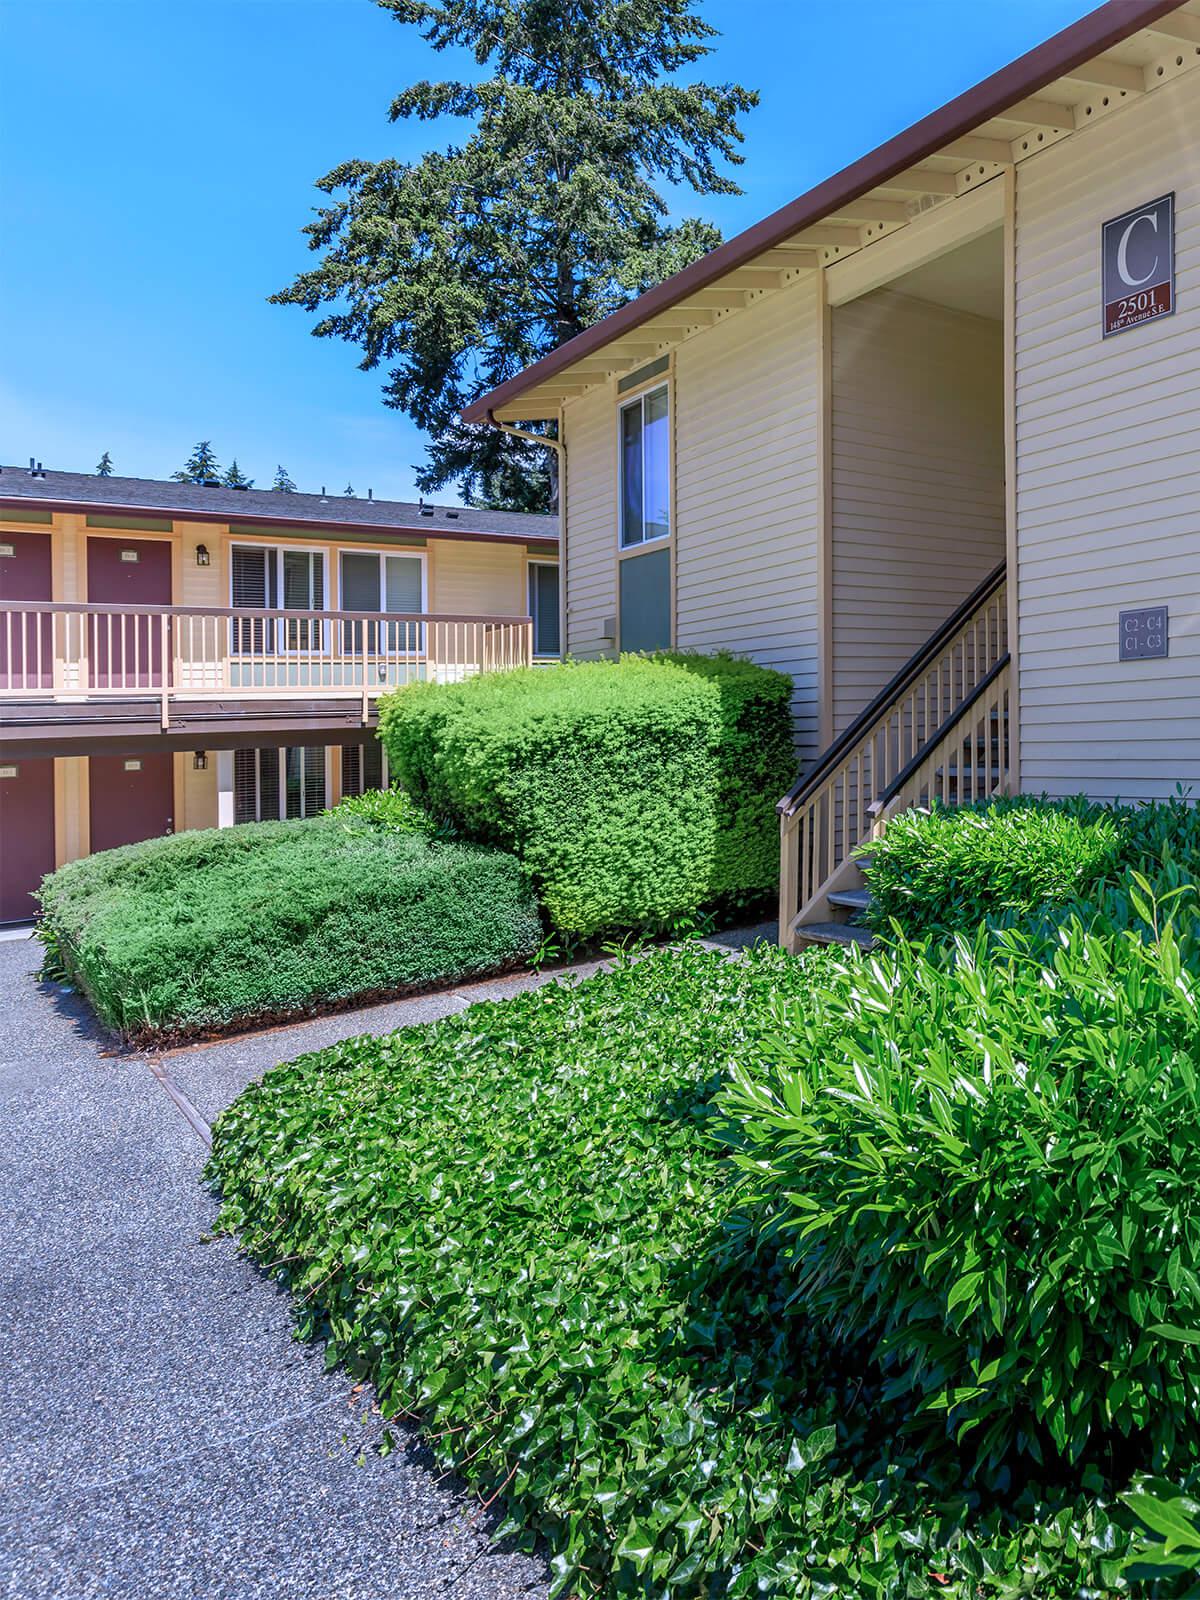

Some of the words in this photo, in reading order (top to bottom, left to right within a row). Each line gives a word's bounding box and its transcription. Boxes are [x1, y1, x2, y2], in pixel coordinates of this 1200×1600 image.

[1117, 211, 1158, 286] C
[1118, 290, 1156, 319] 2501
[1126, 311, 1150, 325] Avenue
[1125, 619, 1139, 633] C2
[1147, 616, 1161, 630] C4
[1125, 637, 1138, 650] C1
[1147, 634, 1161, 648] C3
